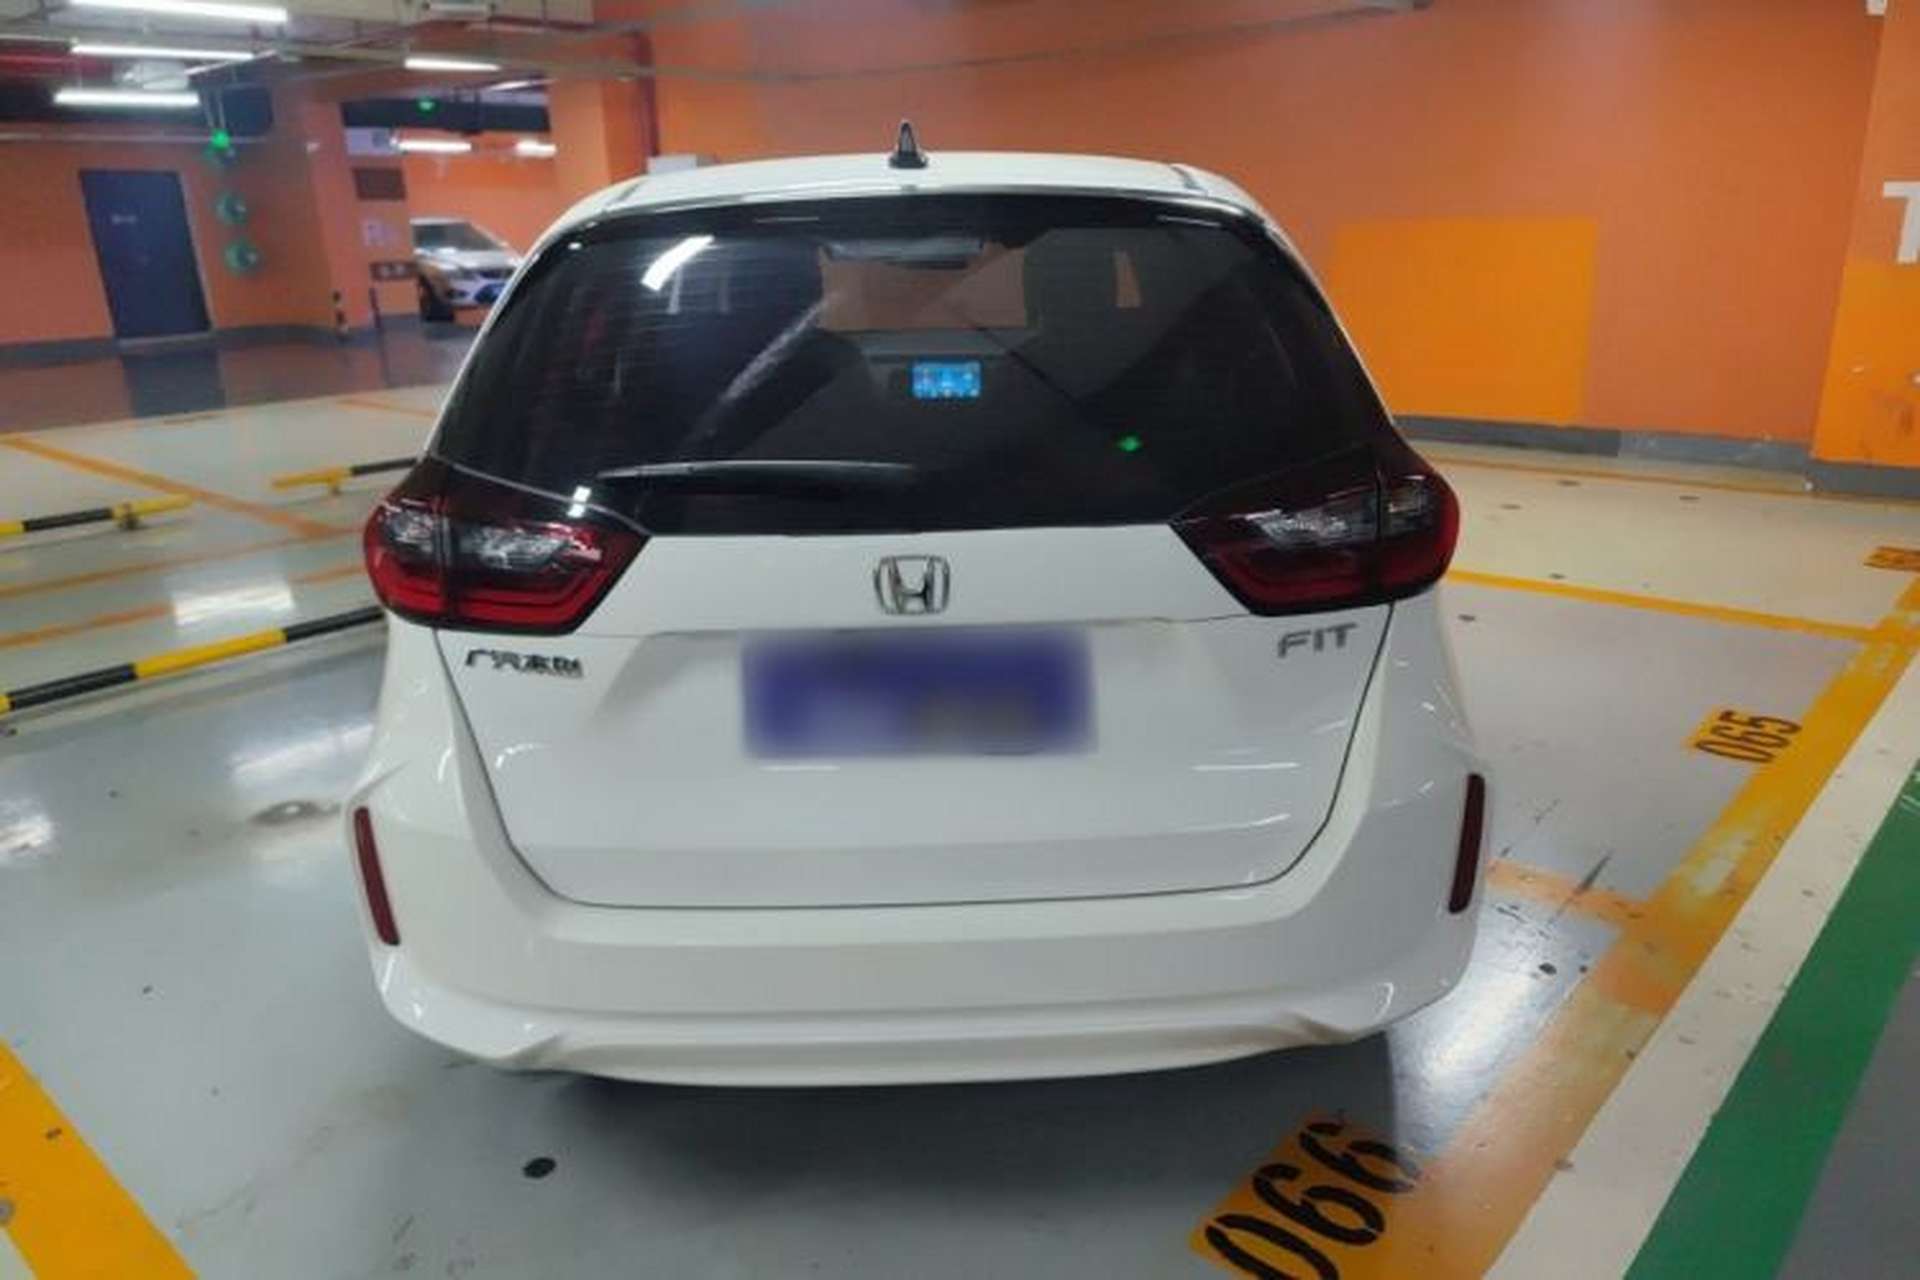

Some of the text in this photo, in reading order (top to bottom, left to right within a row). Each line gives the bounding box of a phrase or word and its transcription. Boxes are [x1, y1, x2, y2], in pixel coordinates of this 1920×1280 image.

[1278, 622, 1357, 659] FIT
[1695, 710, 1802, 763] 065
[1205, 1122, 1422, 1280] 066
